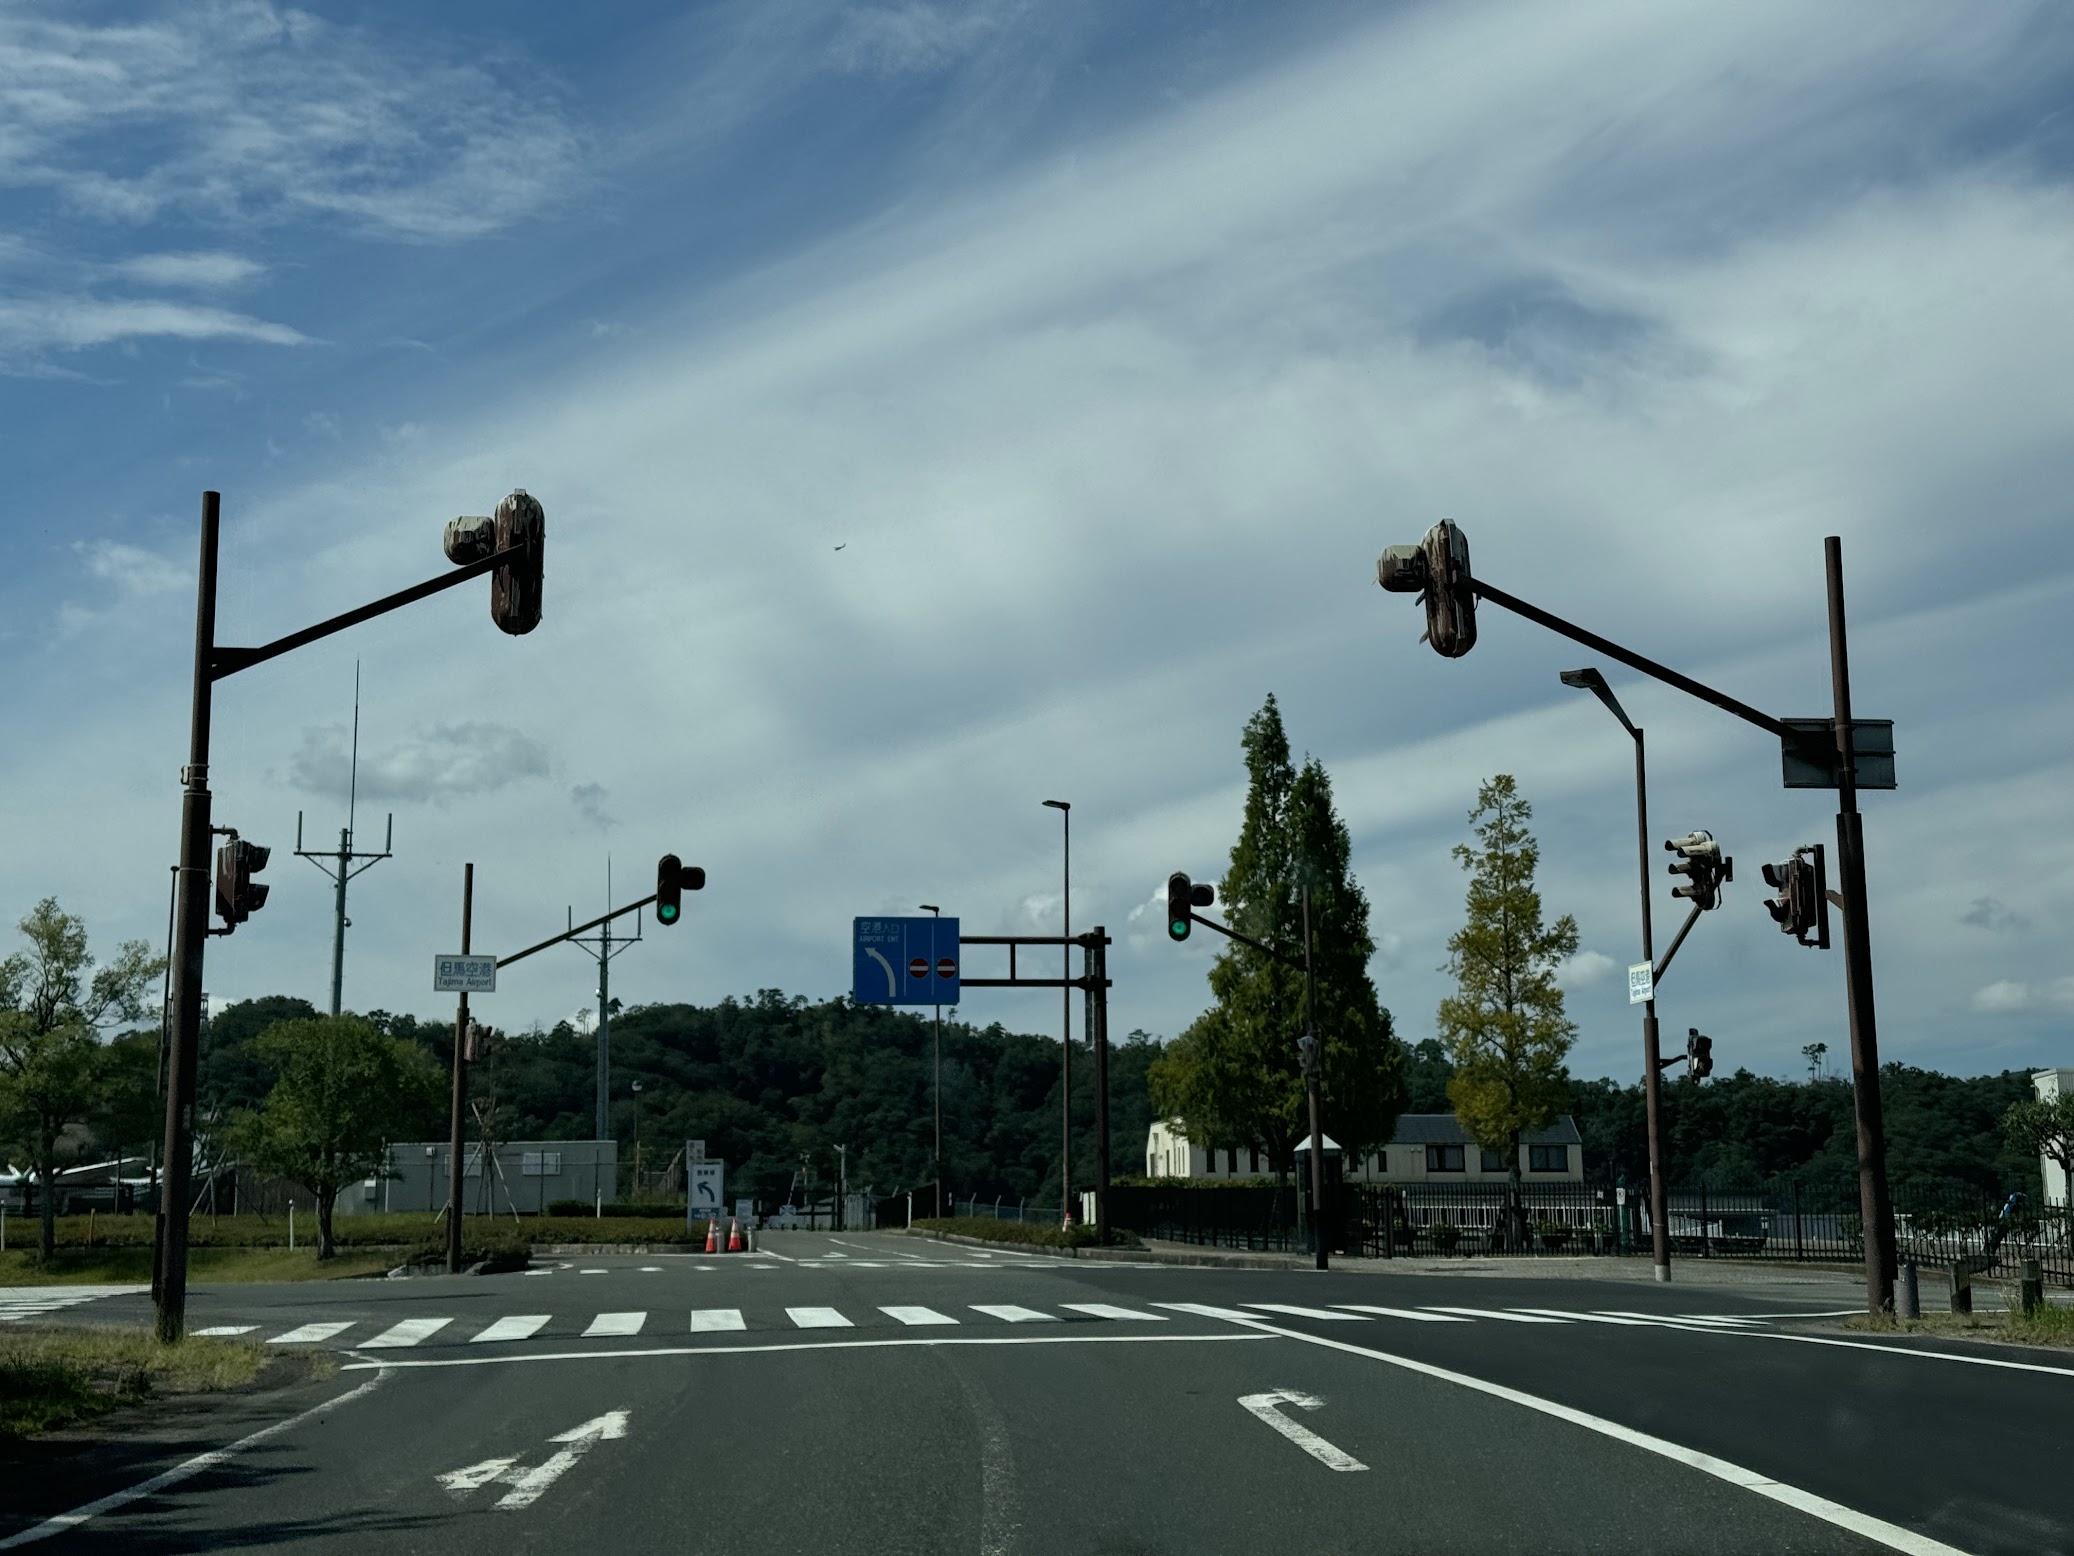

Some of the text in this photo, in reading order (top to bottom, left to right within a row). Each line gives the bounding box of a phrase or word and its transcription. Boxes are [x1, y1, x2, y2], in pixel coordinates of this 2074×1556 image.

[441, 961, 492, 977] 但馬空港
[438, 977, 492, 988] Tajima Airport
